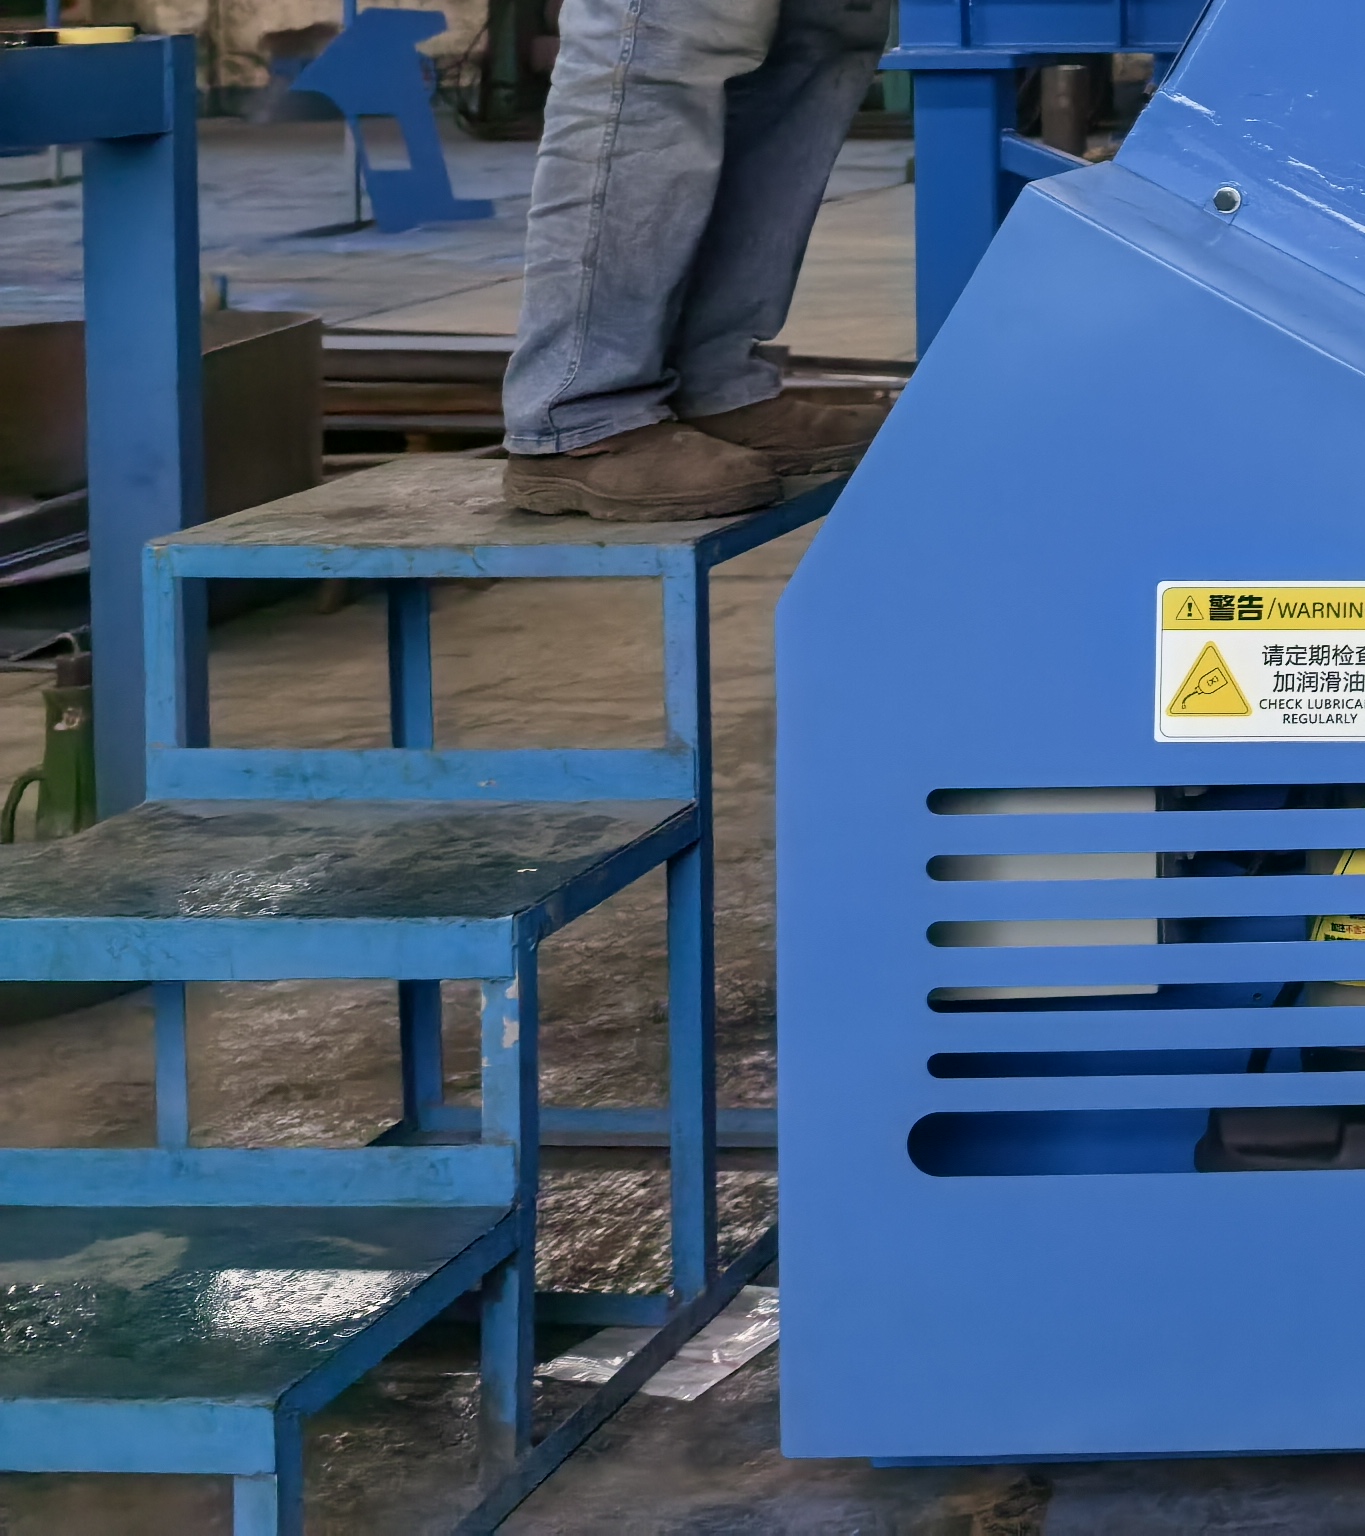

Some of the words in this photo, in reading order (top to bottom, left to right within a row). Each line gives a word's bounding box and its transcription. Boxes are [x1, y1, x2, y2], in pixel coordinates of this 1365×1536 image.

[1272, 670, 1365, 693] 加润滑油
[1259, 698, 1303, 710] CHECK
[1282, 713, 1358, 725] REGULARLY
